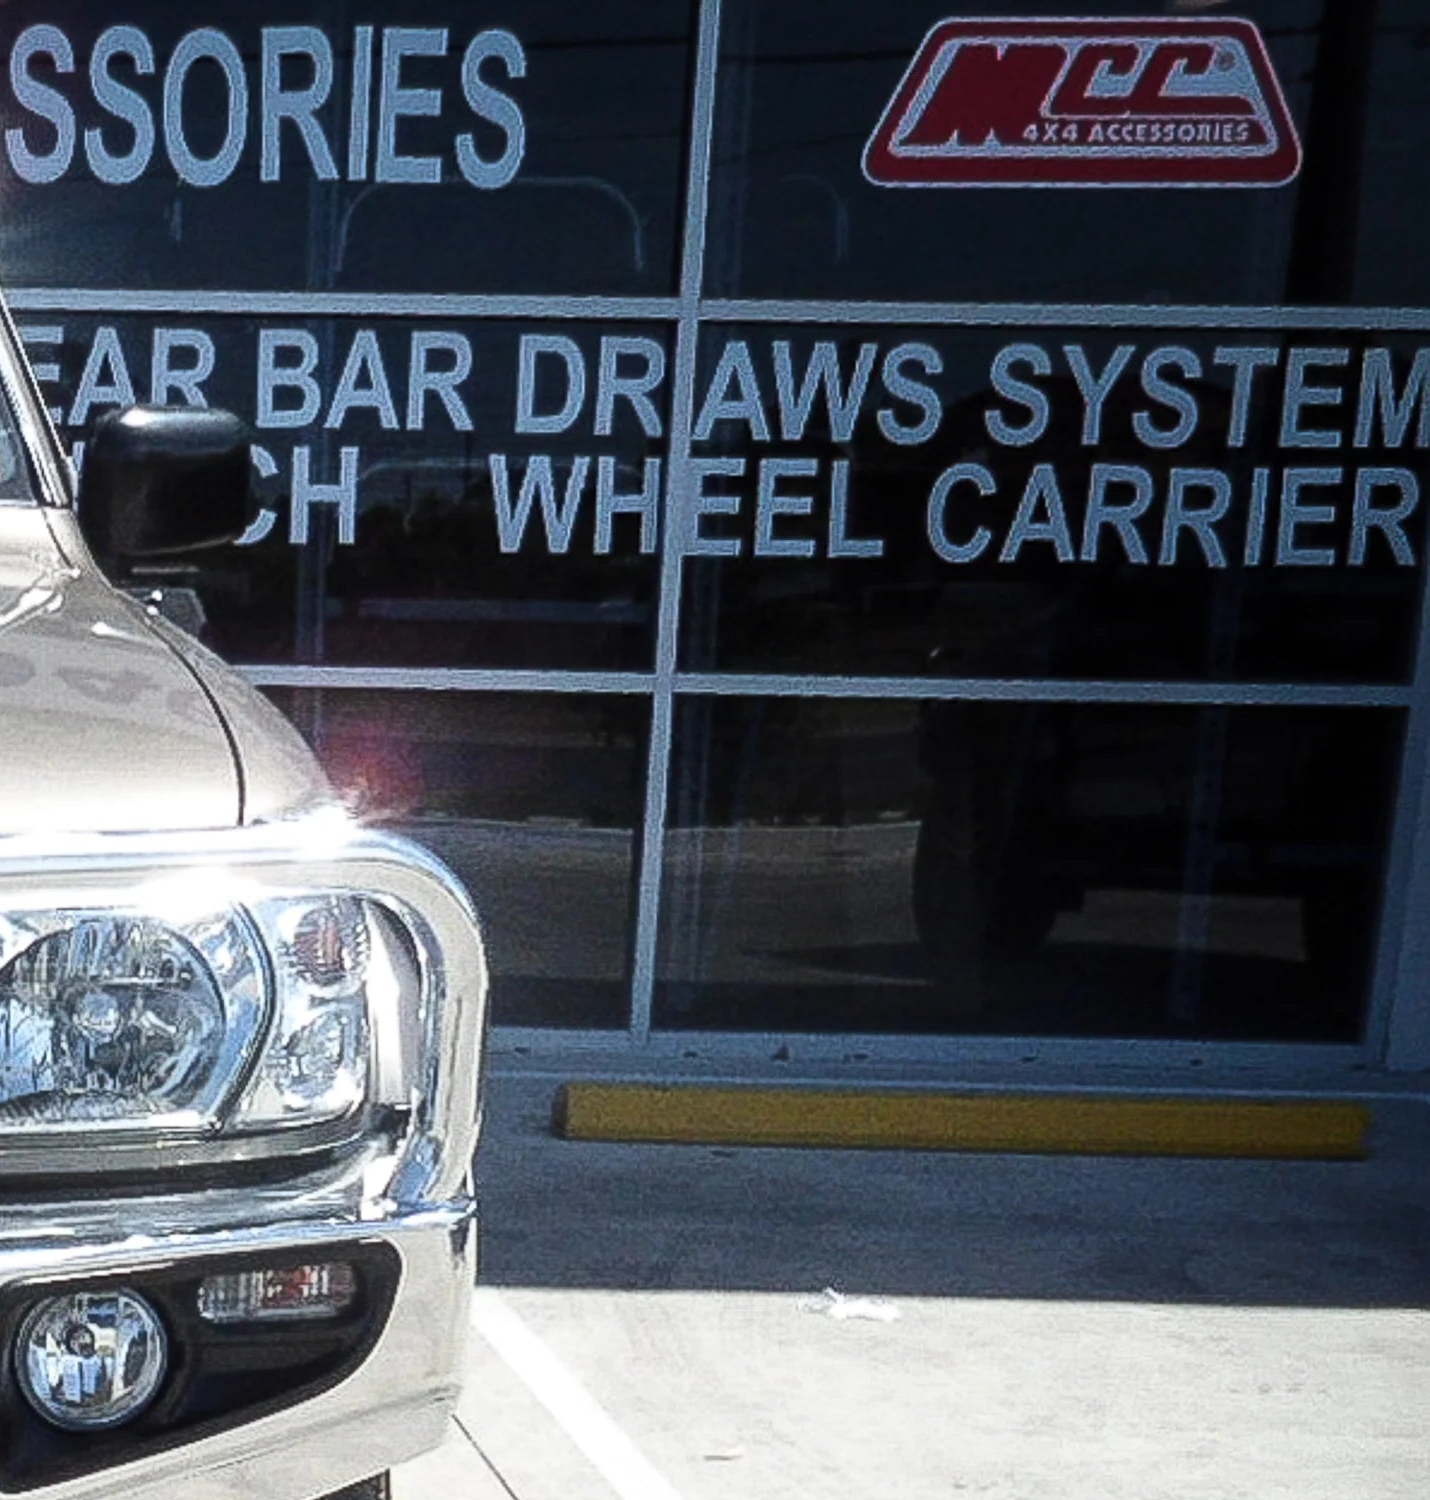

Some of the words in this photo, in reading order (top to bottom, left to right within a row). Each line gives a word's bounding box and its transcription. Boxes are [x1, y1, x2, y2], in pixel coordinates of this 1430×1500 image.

[900, 44, 1256, 144] MCC
[1021, 123, 1080, 142] 4X4
[1089, 122, 1250, 143] ACCESSORIES
[21, 326, 216, 426] EAR
[256, 328, 473, 432] BAR
[514, 333, 943, 447] DRAWS
[984, 344, 1430, 450] SYSTEM
[488, 454, 884, 558] WHEEL
[928, 462, 1418, 568] CARRIER
